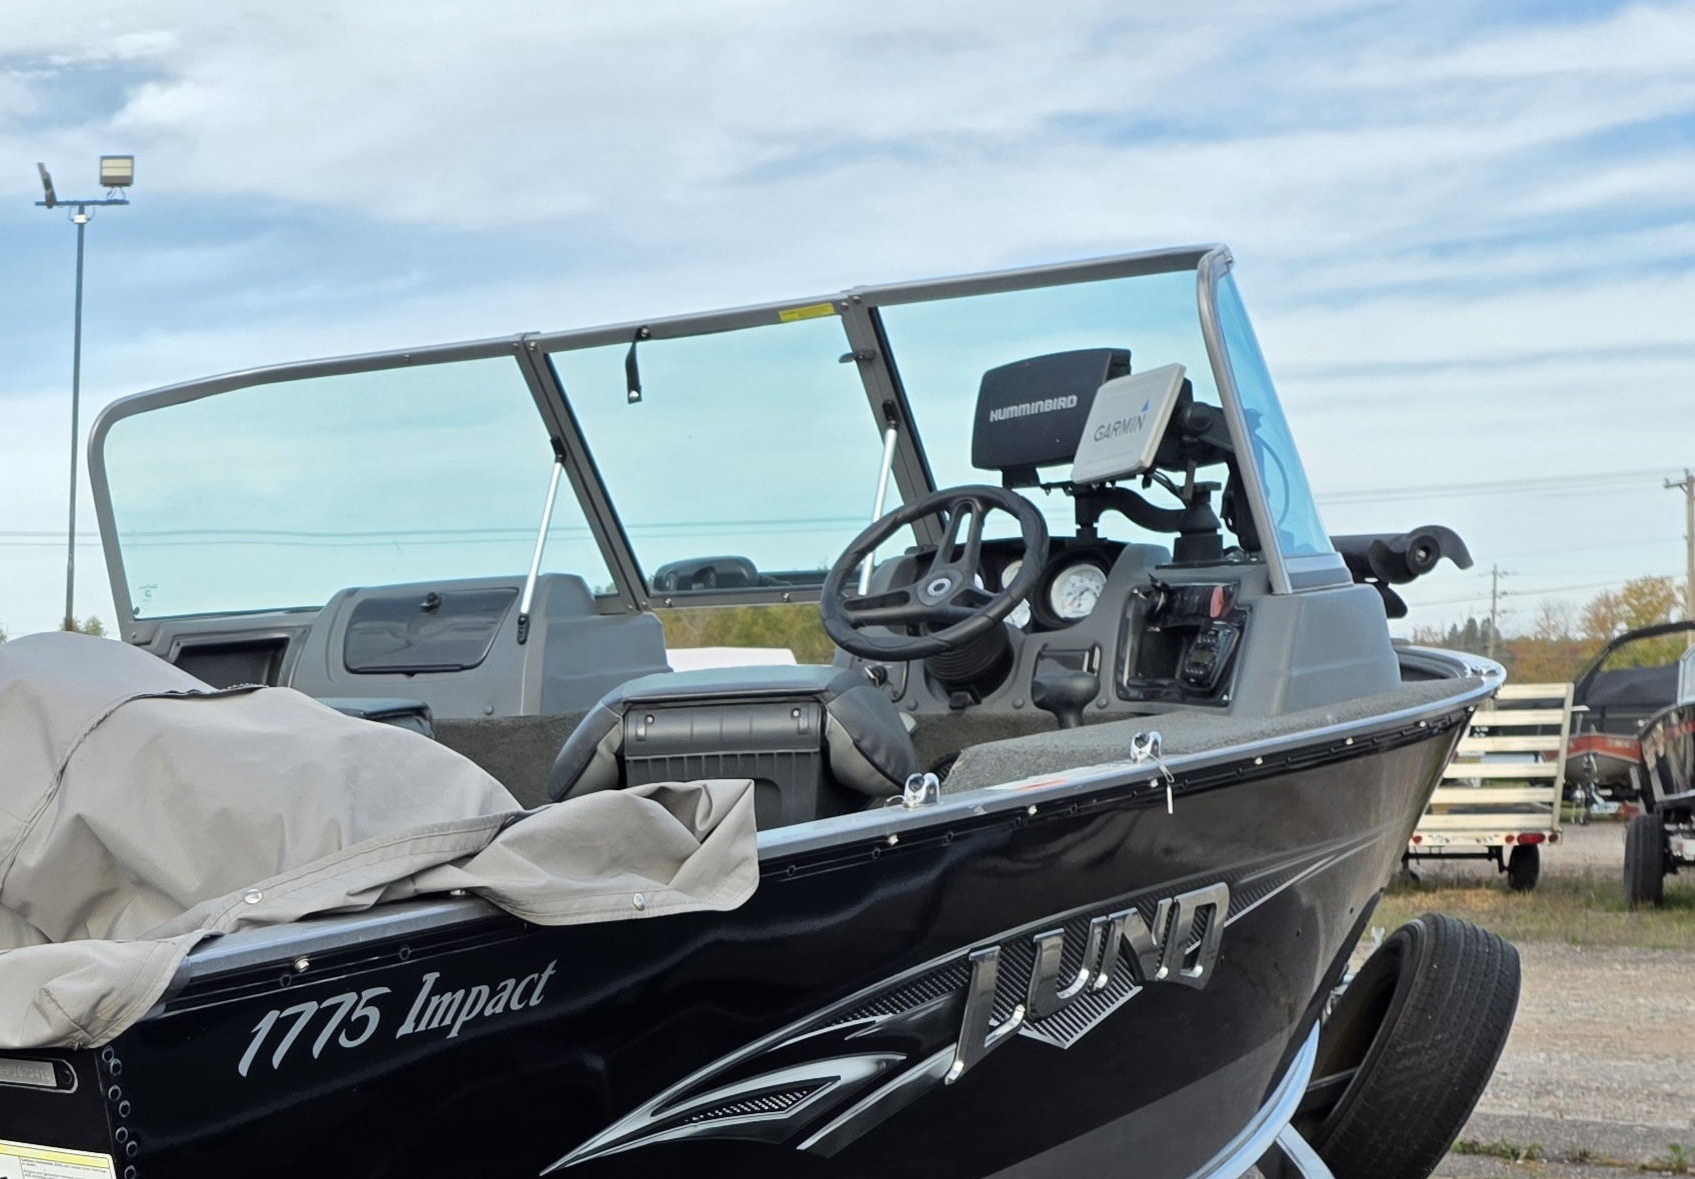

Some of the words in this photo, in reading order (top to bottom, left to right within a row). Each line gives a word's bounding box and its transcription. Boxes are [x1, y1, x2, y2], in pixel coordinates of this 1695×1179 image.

[989, 394, 1078, 422] HUMMINBIRD
[1094, 413, 1147, 442] GARMIN
[237, 986, 392, 1078] 1775
[395, 958, 558, 1039] Impact
[944, 881, 1231, 1086] LUND
